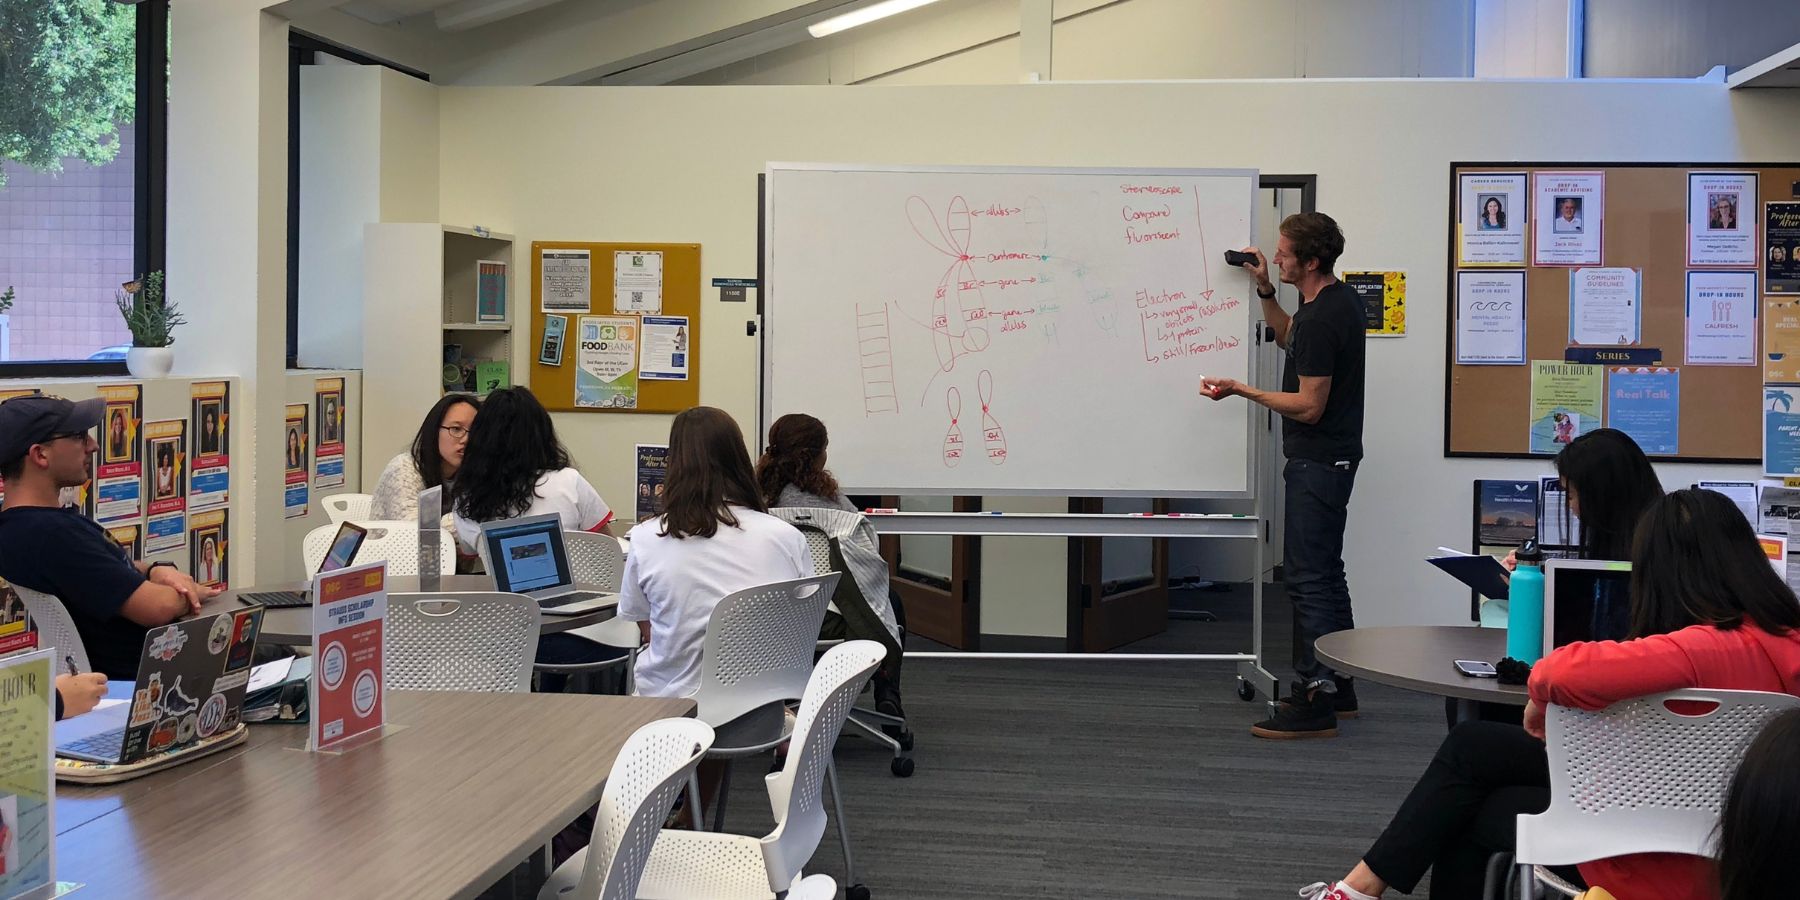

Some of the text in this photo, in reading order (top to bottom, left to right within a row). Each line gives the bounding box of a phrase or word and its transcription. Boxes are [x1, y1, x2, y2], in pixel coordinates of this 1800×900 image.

[1539, 364, 1593, 376] POWER HOUR
[1616, 389, 1671, 400] Real Talk
